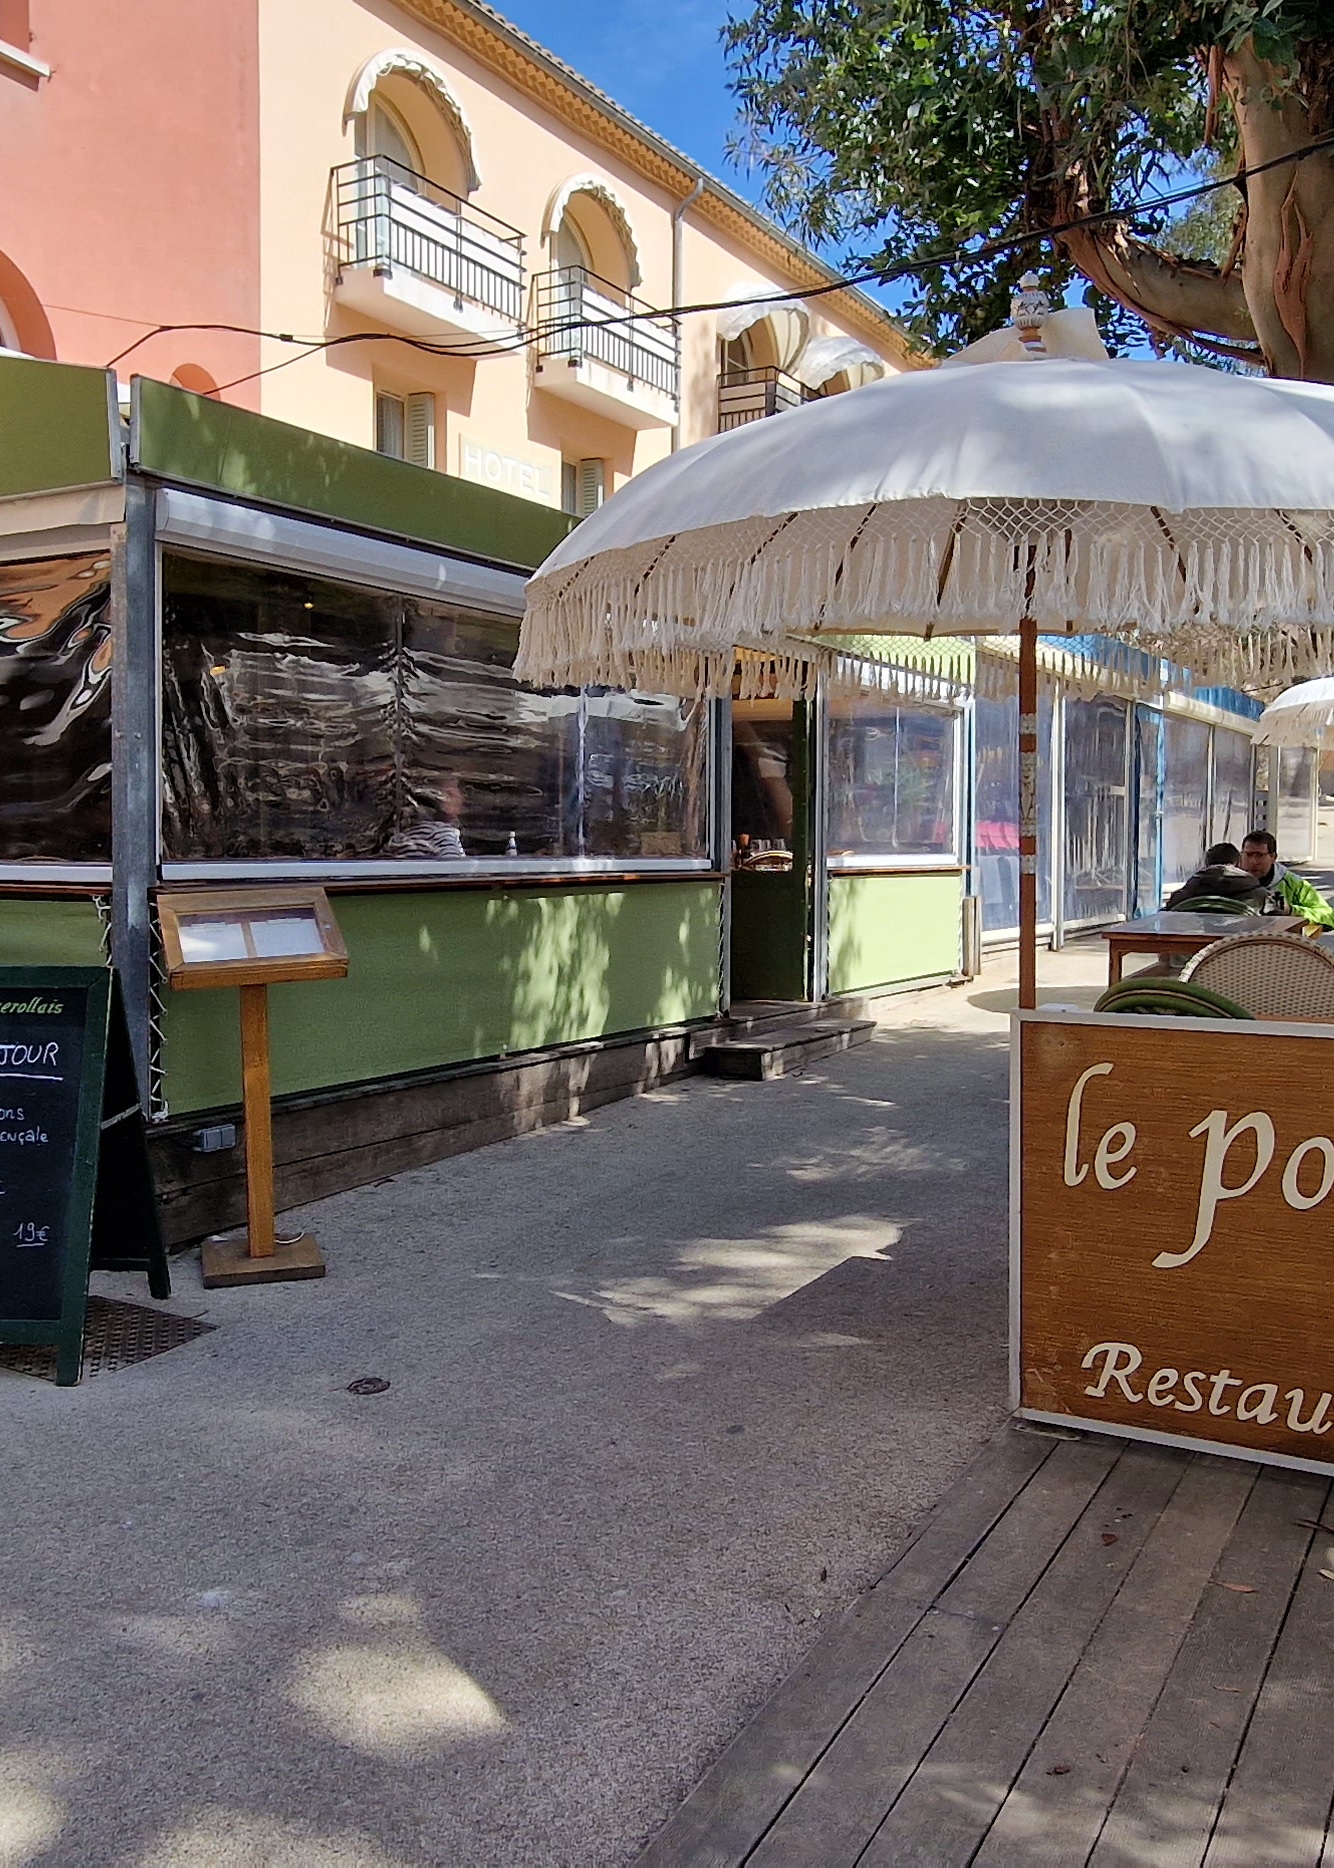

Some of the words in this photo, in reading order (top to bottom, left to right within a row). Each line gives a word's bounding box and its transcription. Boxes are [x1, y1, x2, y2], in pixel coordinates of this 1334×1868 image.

[464, 444, 550, 500] HOTEL
[1063, 1061, 1138, 1192] le
[12, 1221, 51, 1243] 19€
